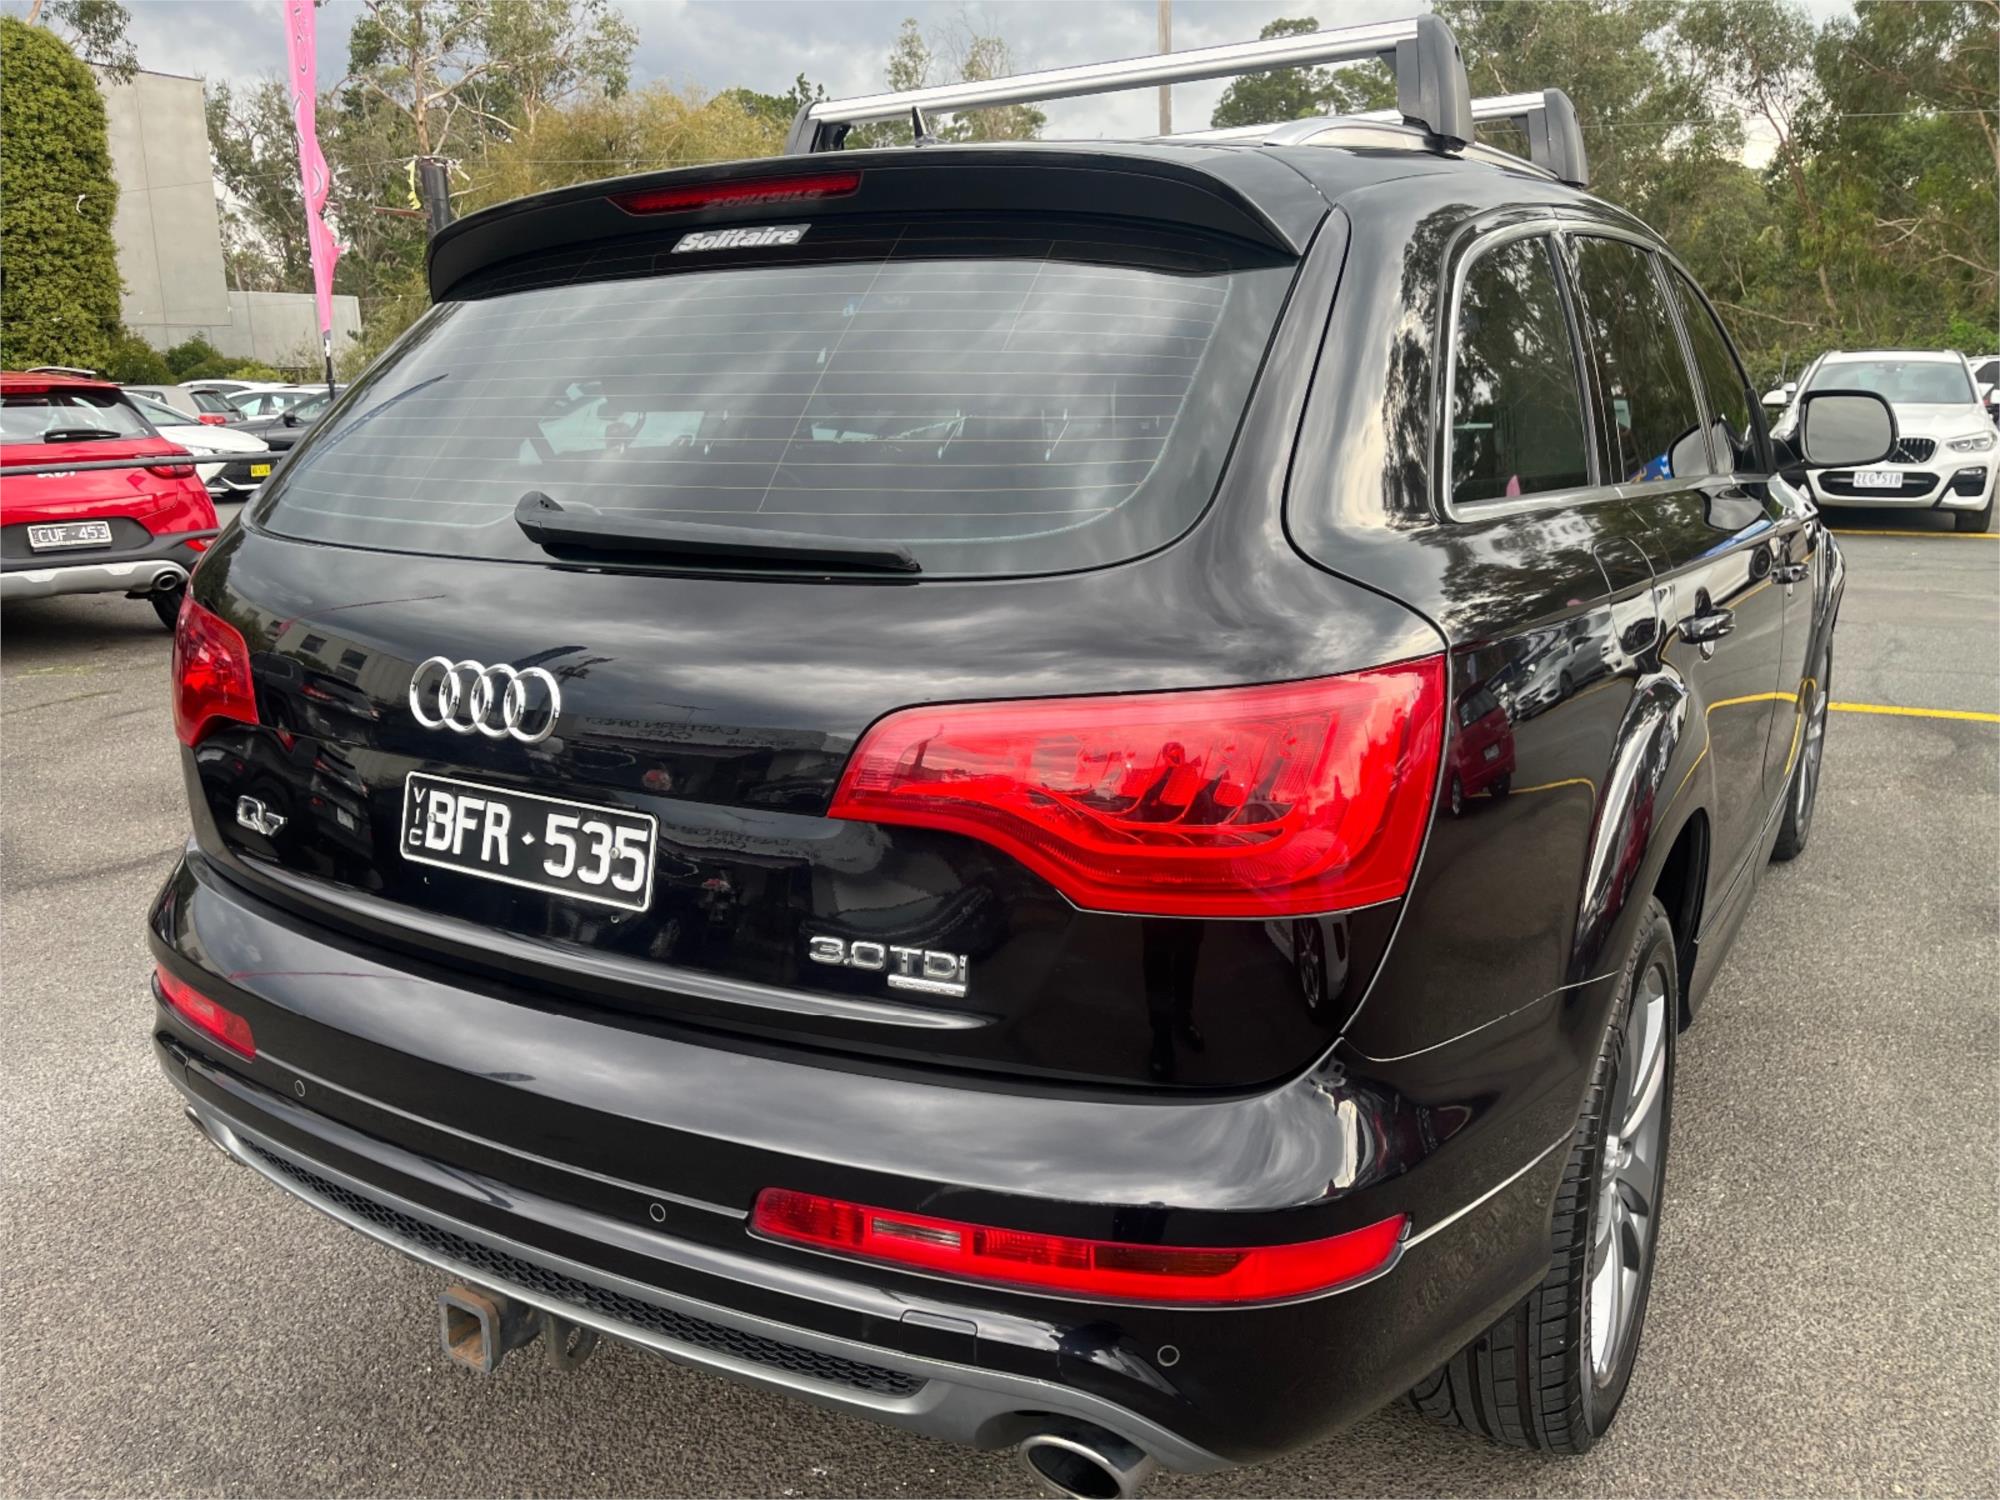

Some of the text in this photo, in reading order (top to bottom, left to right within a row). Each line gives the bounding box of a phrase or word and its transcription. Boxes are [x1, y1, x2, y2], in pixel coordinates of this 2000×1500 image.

[678, 227, 799, 252] Solitaire
[38, 525, 107, 542] CUF 453
[237, 795, 285, 836] Q7
[408, 786, 426, 846] VIC
[425, 790, 649, 892] BFR 535
